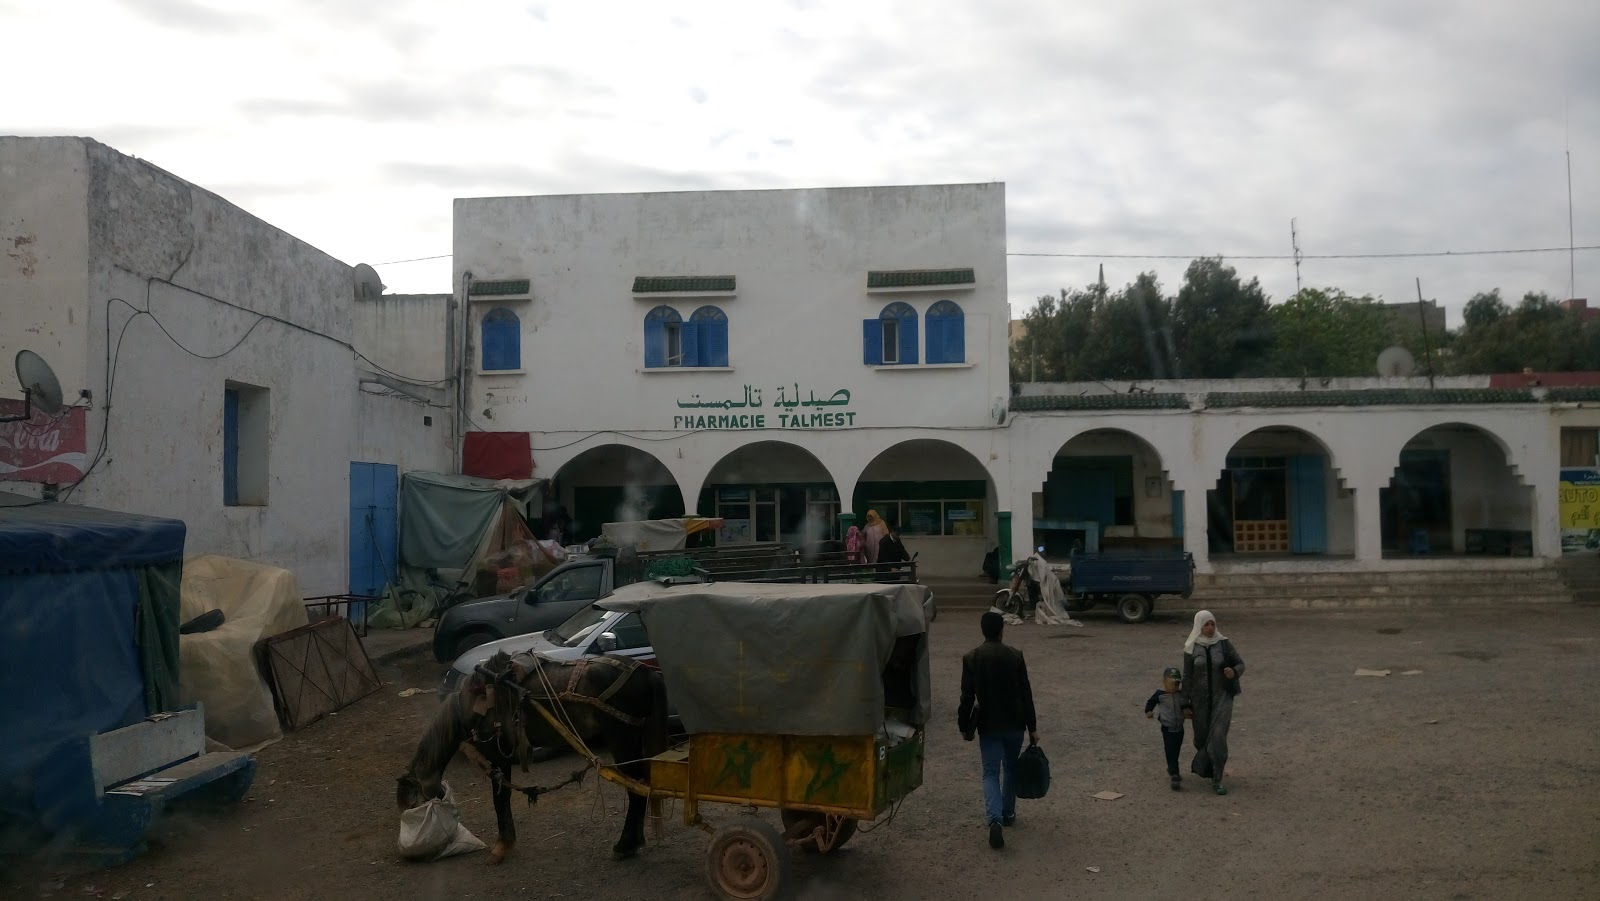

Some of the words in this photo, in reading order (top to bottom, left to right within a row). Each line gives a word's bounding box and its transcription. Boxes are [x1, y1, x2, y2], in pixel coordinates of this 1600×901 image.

[676, 384, 763, 411] تالمست
[773, 382, 851, 412] صيدلية
[673, 415, 765, 429] PHARMACIE
[778, 411, 857, 428] TALMEST
